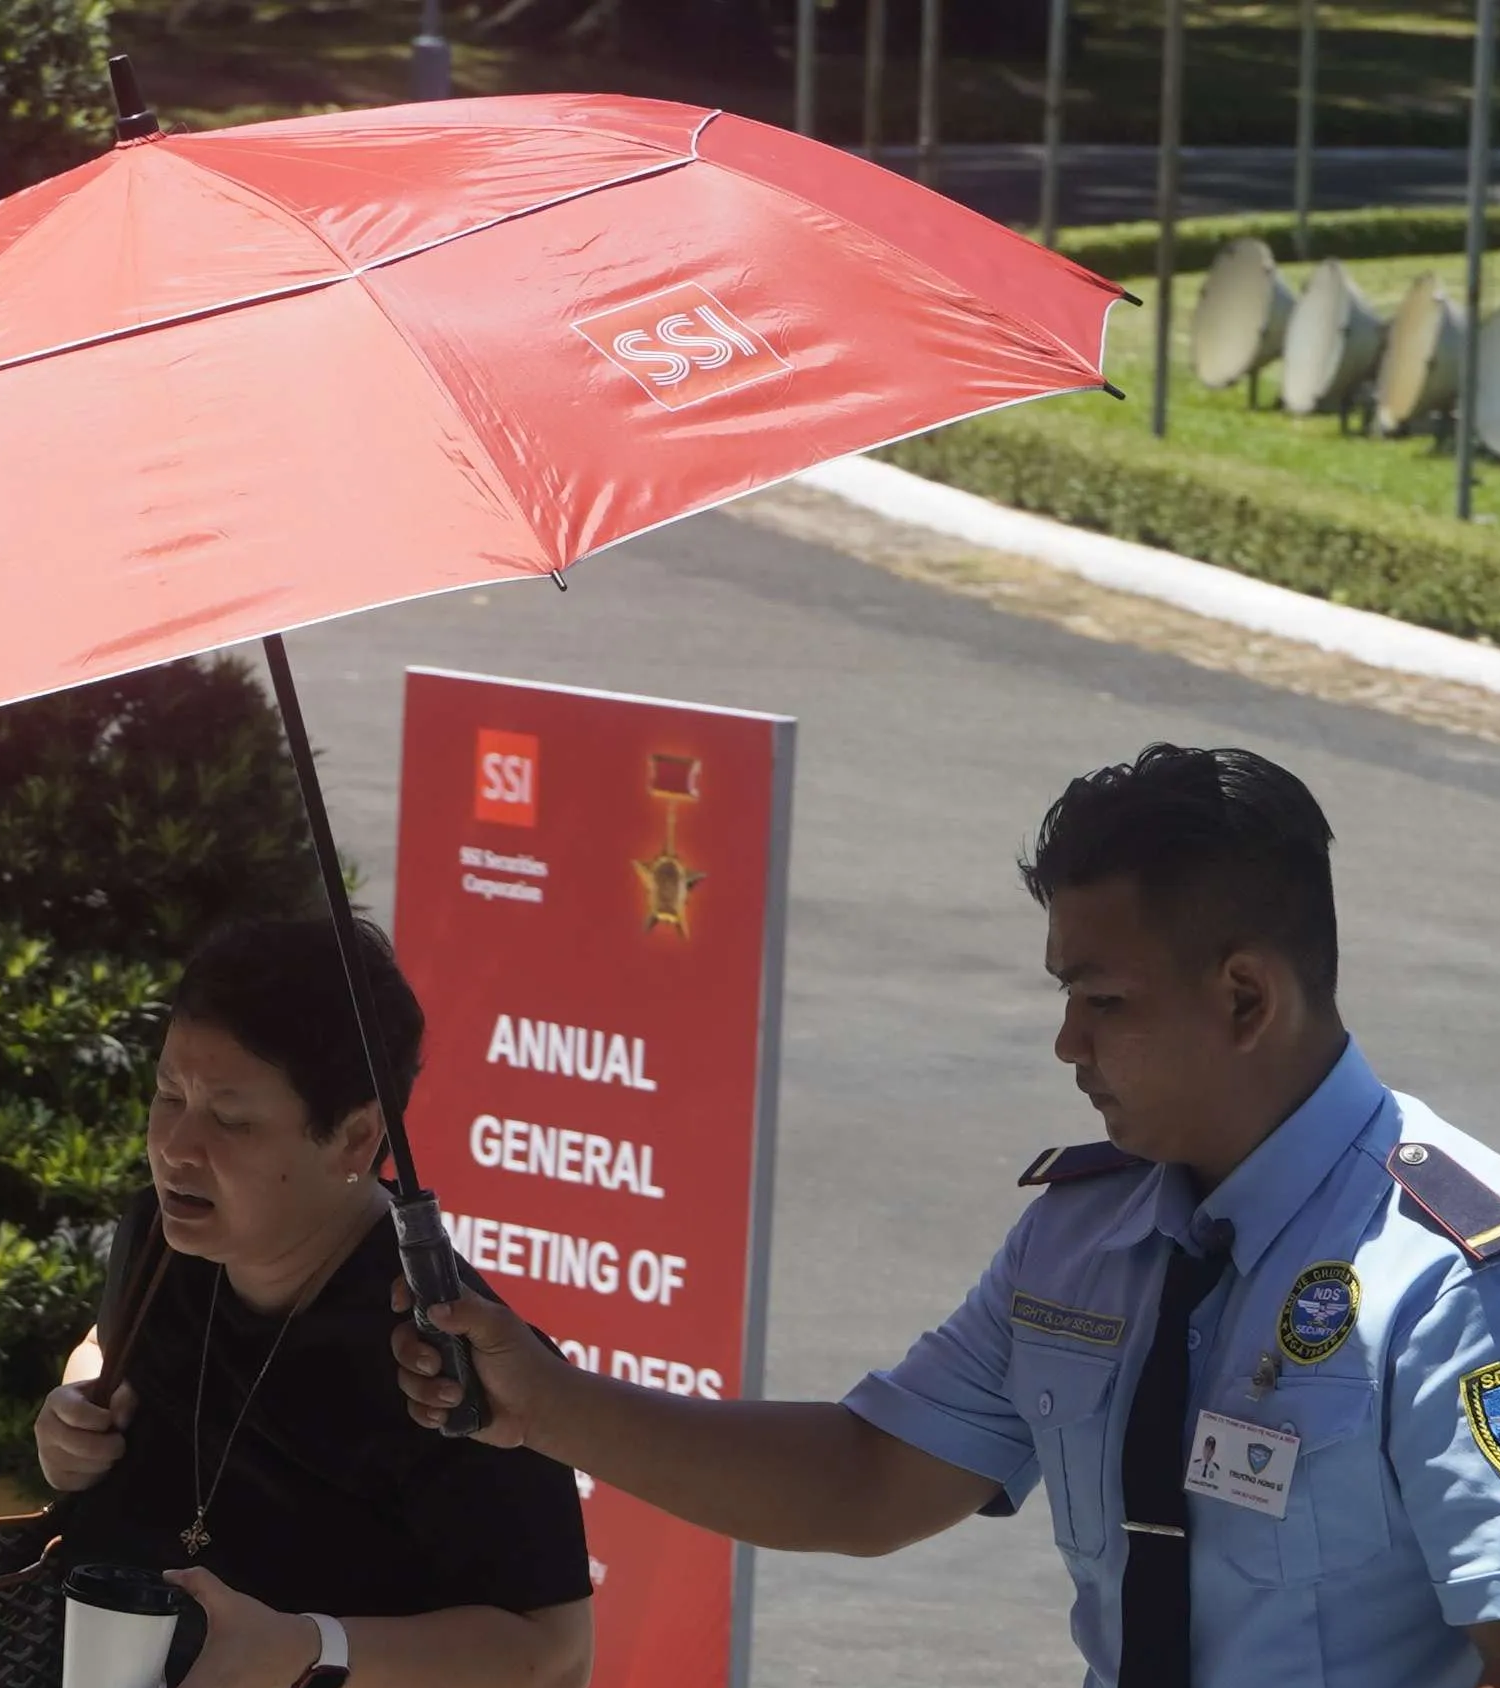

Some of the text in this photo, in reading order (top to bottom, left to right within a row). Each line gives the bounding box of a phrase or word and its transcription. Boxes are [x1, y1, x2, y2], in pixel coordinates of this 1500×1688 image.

[612, 304, 758, 386] SSI
[481, 751, 533, 804] SSI
[486, 1013, 658, 1092] ANNUAL
[469, 1114, 664, 1199] GENERAL
[439, 1211, 687, 1306] MEETING OF
[1313, 1287, 1341, 1301] NDS
